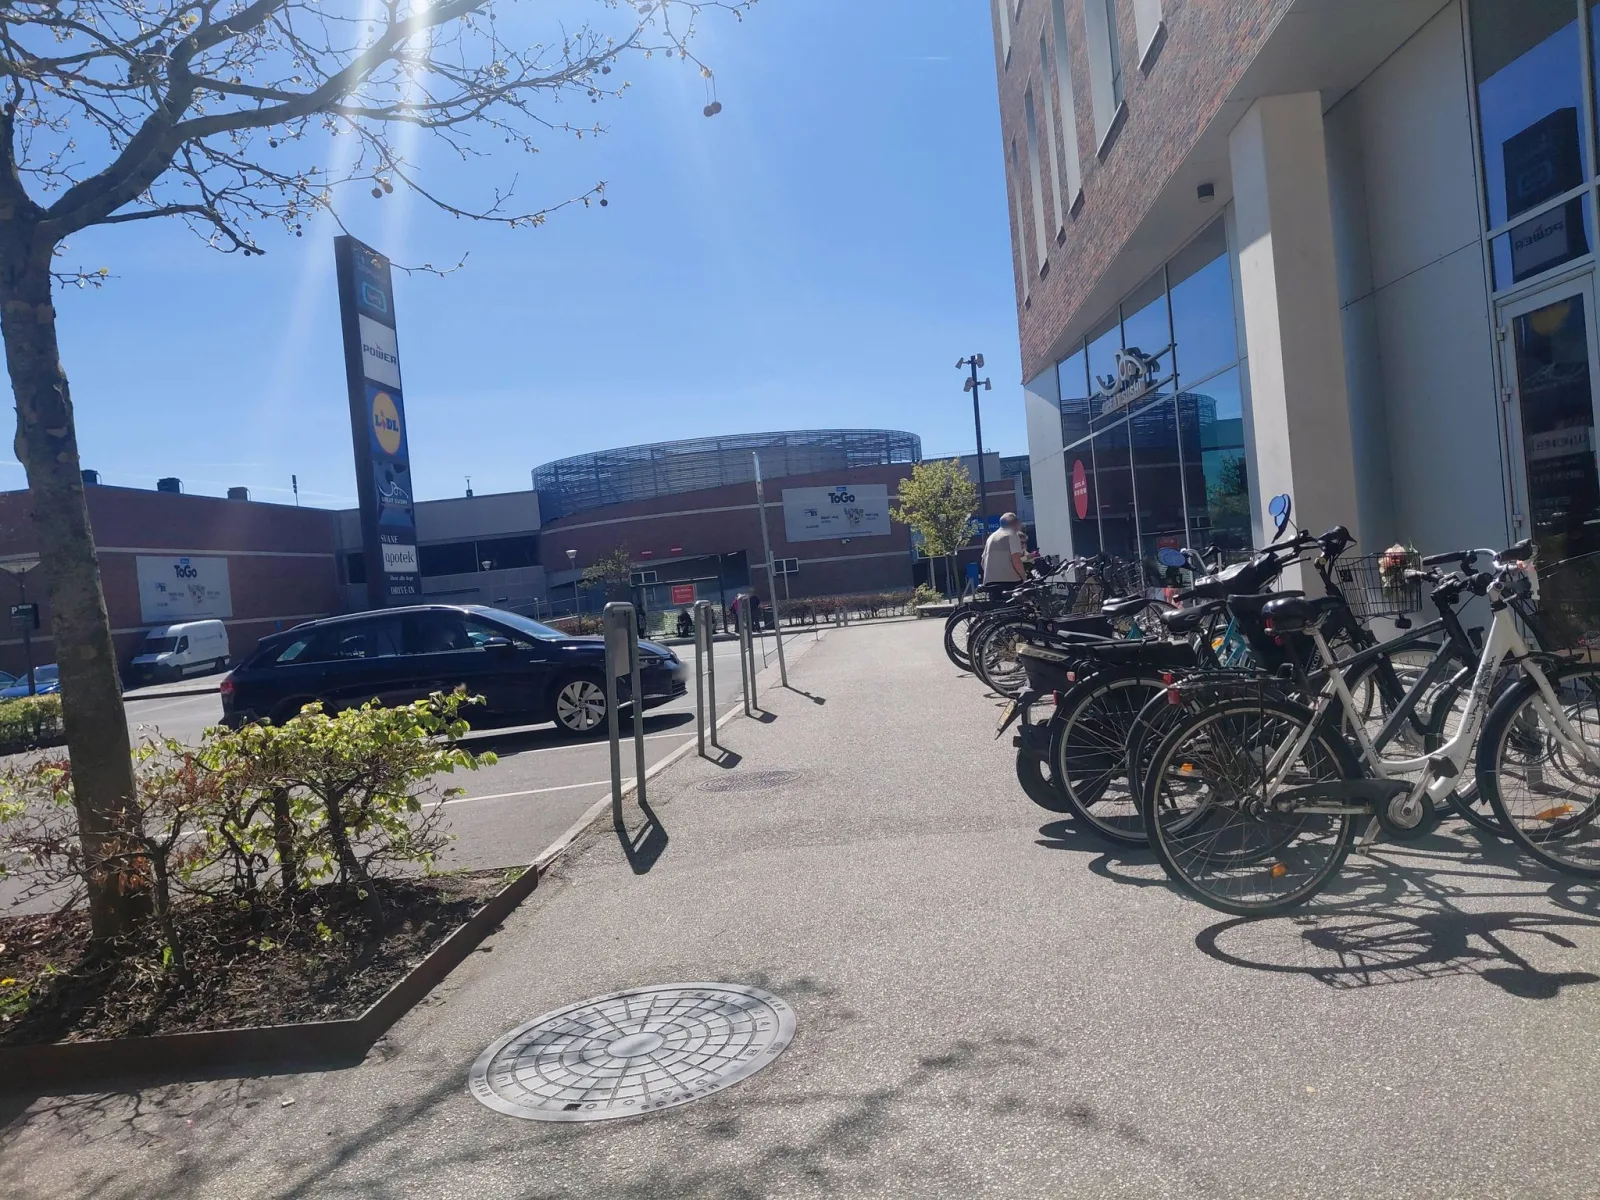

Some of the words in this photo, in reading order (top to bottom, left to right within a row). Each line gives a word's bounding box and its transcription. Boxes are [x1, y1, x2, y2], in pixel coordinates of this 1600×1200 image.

[363, 343, 397, 365] POWER
[828, 491, 856, 504] ToGo
[381, 534, 399, 544] SVANE
[385, 551, 415, 567] apotek
[173, 565, 198, 578] ToGo
[390, 586, 415, 595] DRIVE-IN
